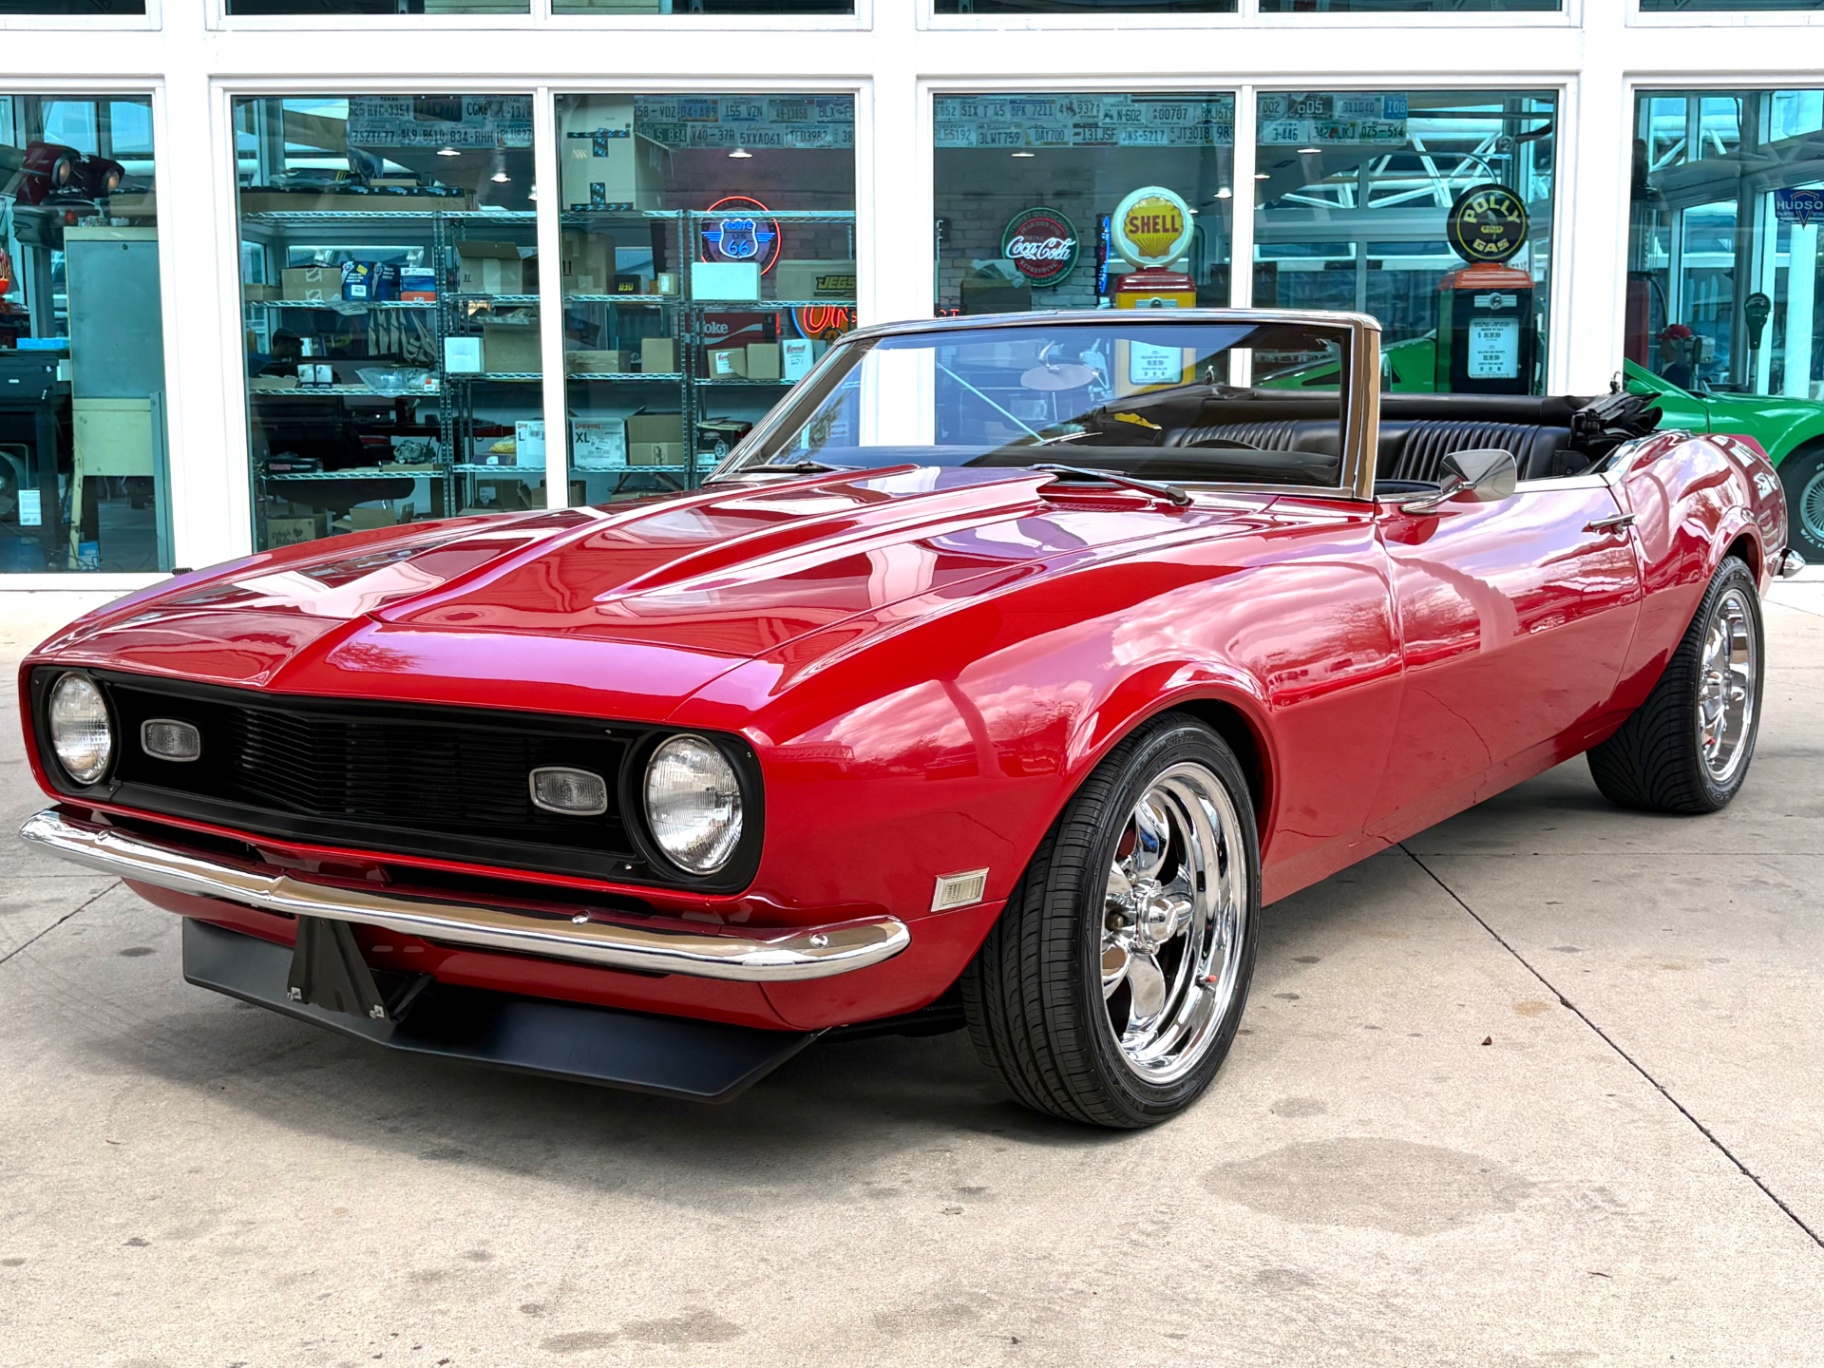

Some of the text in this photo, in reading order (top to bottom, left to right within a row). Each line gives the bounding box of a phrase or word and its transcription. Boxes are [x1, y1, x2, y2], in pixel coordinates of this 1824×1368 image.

[960, 104, 979, 117] SIX
[994, 104, 1006, 117] 45
[1463, 195, 1520, 224] POLLY
[1128, 215, 1180, 234] SHELL
[727, 240, 751, 255] 66
[1006, 235, 1077, 260] Coca-Cola
[1472, 238, 1510, 253] GAS
[518, 432, 525, 442] L
[575, 432, 591, 444] XL
